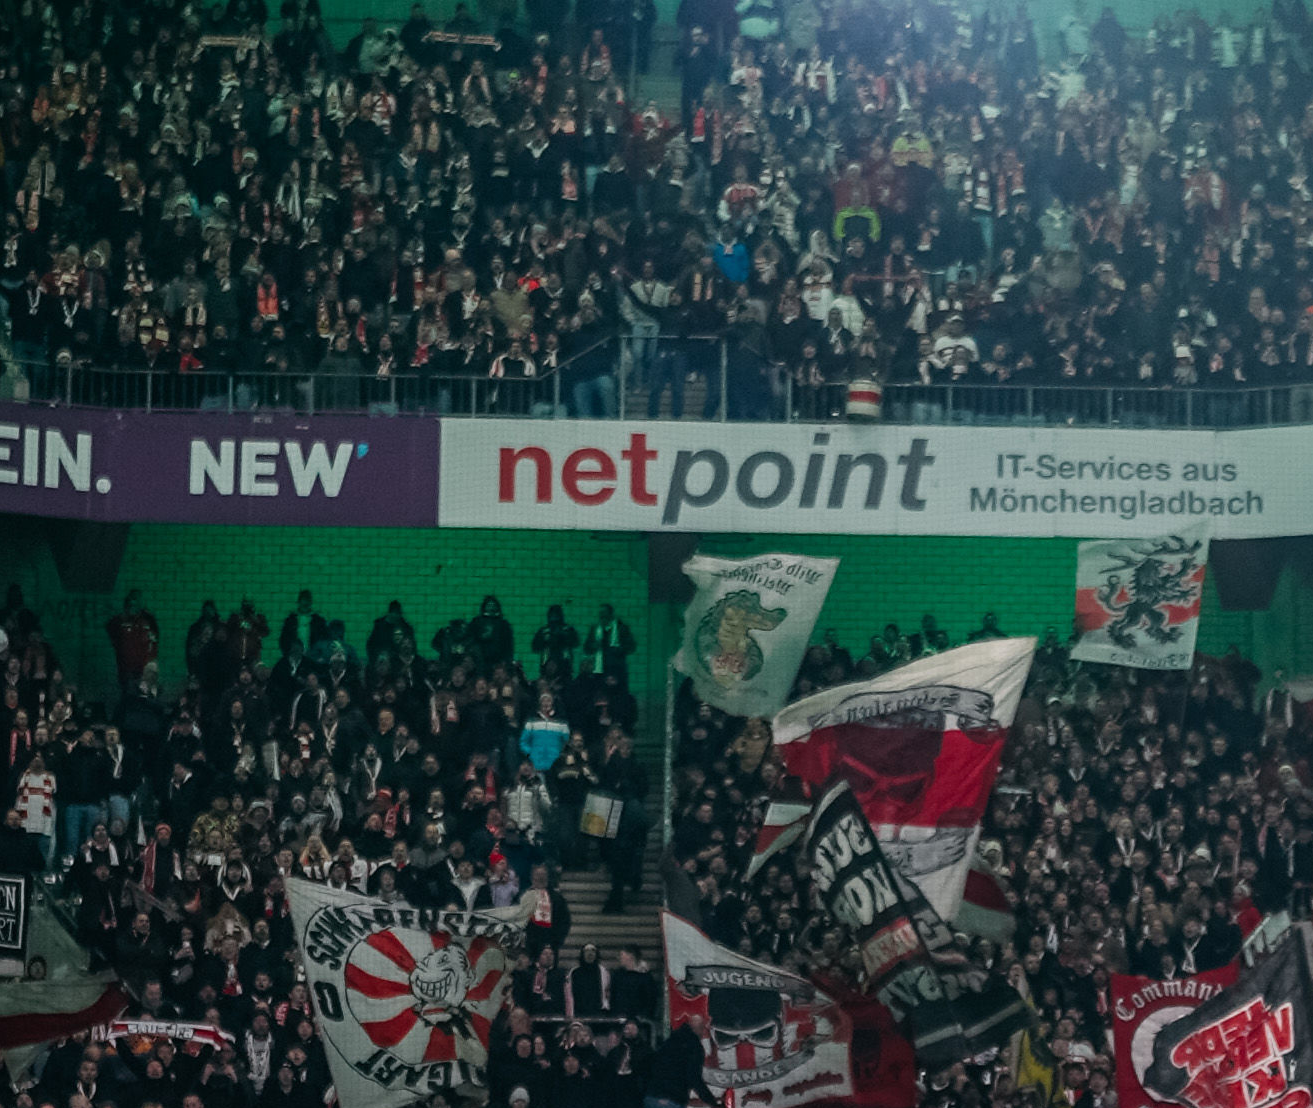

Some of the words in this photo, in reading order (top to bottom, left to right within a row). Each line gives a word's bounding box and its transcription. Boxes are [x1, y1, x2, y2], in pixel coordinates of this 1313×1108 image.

[498, 432, 934, 525] netpoint
[996, 454, 1171, 484] IT-Services
[1181, 461, 1237, 484] aus
[970, 486, 1264, 519] Mönchengladbach
[1115, 979, 1223, 1022] Comman
